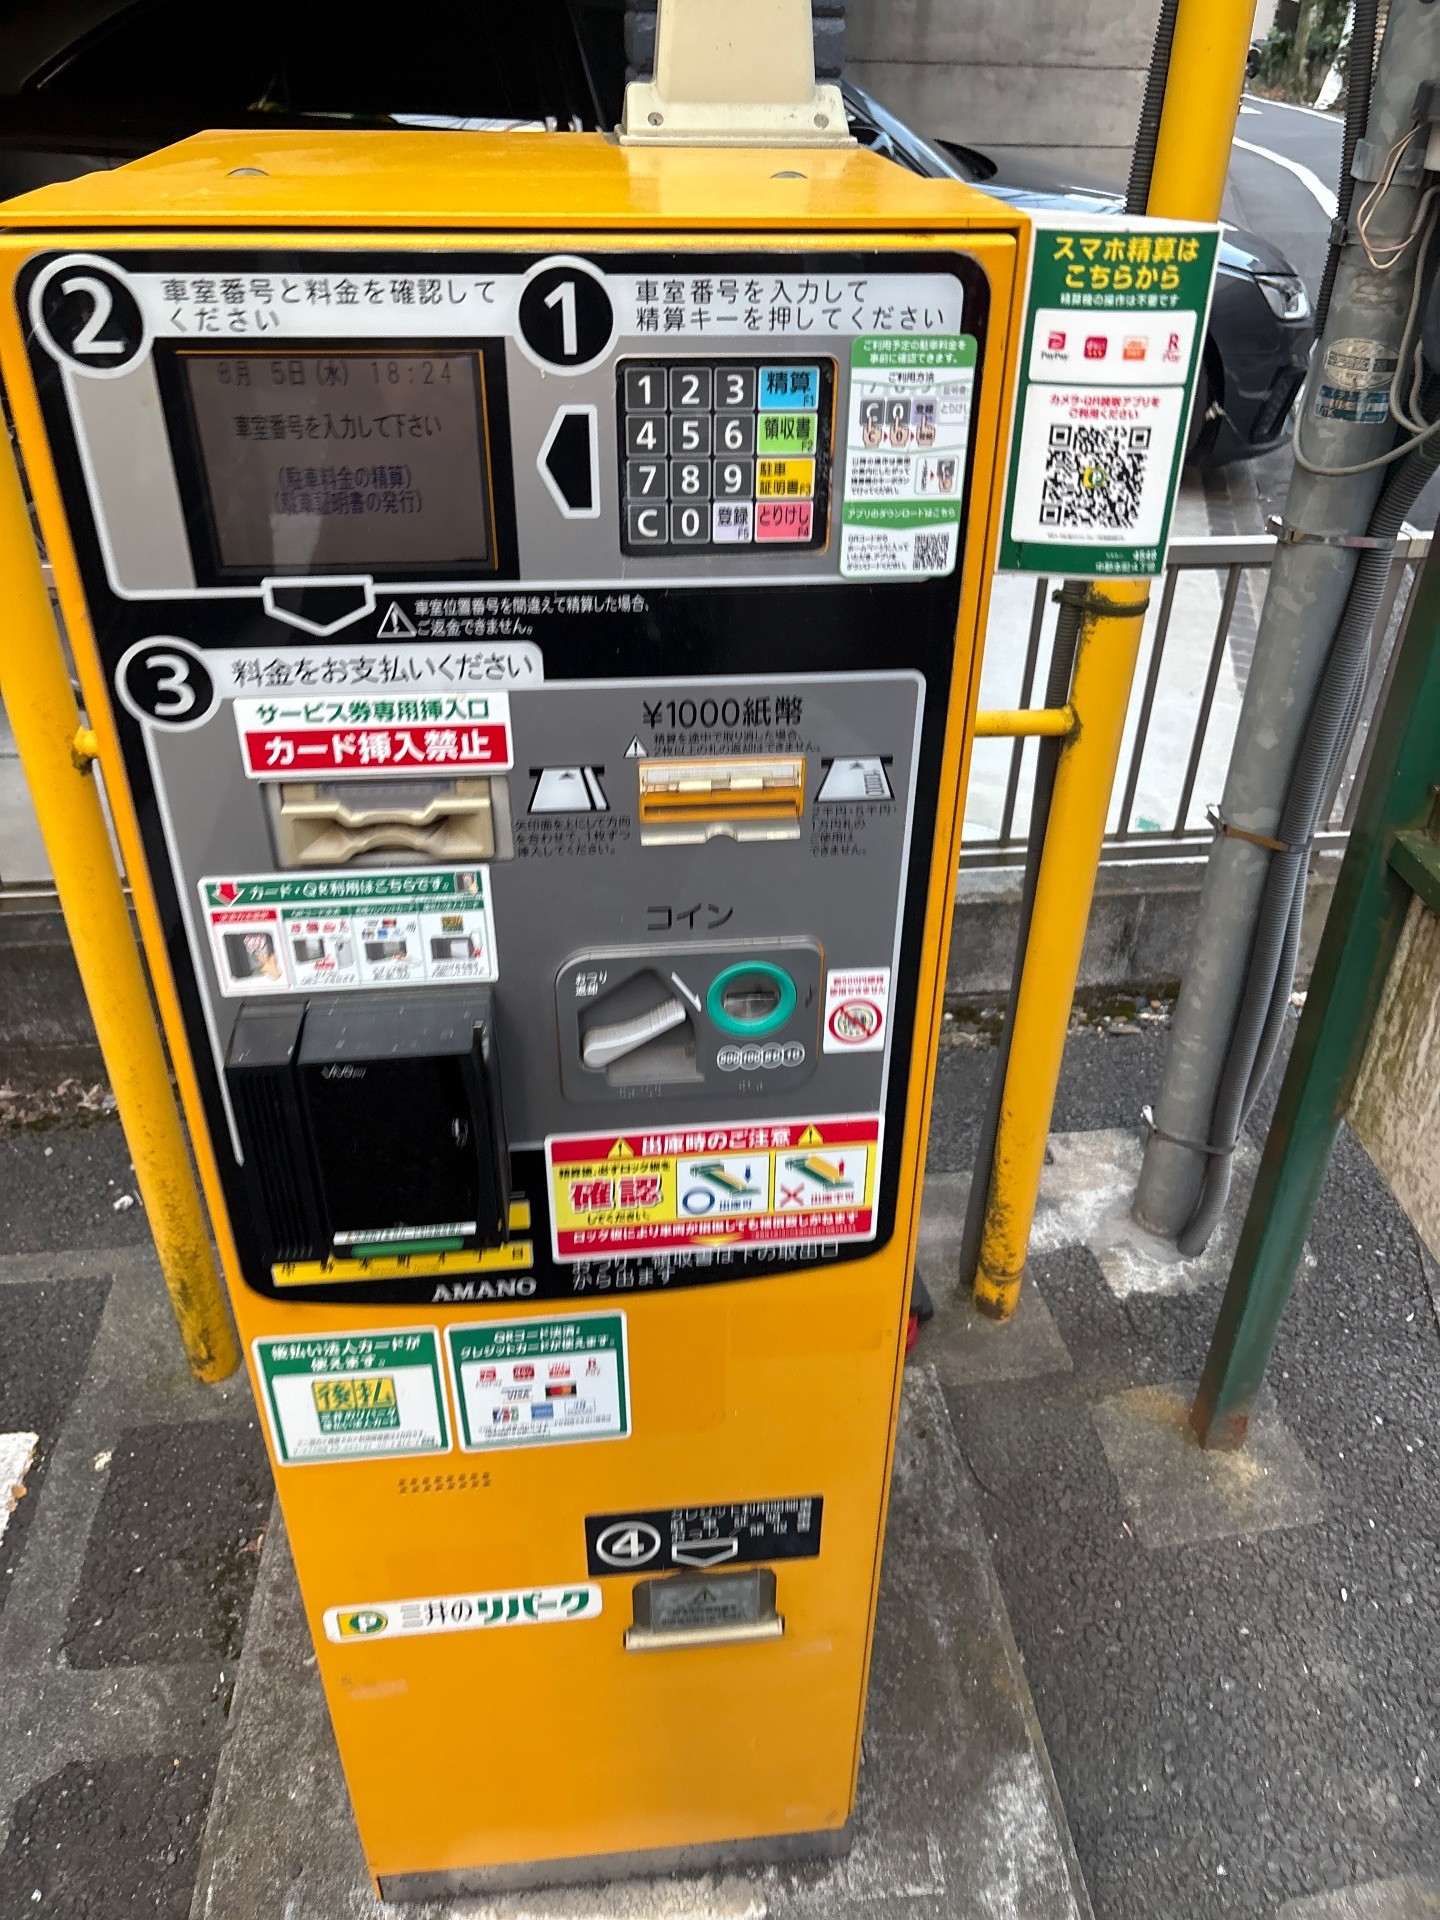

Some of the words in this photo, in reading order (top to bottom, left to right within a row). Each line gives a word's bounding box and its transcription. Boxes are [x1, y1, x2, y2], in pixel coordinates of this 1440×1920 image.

[1053, 237, 1200, 262] スマホ精算は
[161, 278, 496, 306] 車室番号と料金を確認して
[634, 279, 868, 305] 車室番号を入力して
[1064, 265, 1180, 291] こちらから
[61, 277, 125, 354] 2
[170, 306, 281, 333] ください
[544, 281, 577, 356] 1
[635, 306, 945, 332] 精算キーを押してください
[371, 360, 453, 385] 18:24
[767, 371, 810, 395] 精算
[638, 375, 652, 405] 1
[681, 374, 700, 405] 2
[726, 374, 745, 405] 3
[803, 395, 814, 407] F1
[233, 414, 442, 442] 車室番号を入力して下さい
[636, 421, 657, 452] 4
[682, 420, 700, 451] 5
[724, 420, 743, 450] 6
[764, 416, 810, 440] 領収書
[801, 440, 813, 452] F2
[639, 466, 657, 494] 7
[681, 465, 700, 494] 8
[723, 464, 743, 493] 9
[760, 461, 786, 476] 駐車
[759, 480, 799, 495] 証明書
[637, 508, 659, 538] C
[680, 508, 700, 537] 0
[717, 507, 749, 527] 登録
[759, 506, 809, 526] とりけし
[416, 617, 534, 637] ご返金できません。
[232, 652, 533, 688] 料金をお支払いください
[146, 655, 197, 716] 3
[257, 700, 491, 725] サービス券専用挿入口
[265, 729, 492, 766] カード挿入禁止
[646, 904, 733, 931] コイン
[569, 1174, 663, 1213] 確認
[432, 1276, 537, 1302] AMANO
[612, 1528, 645, 1557] 4
[400, 1588, 590, 1629] 三井のリパーク
